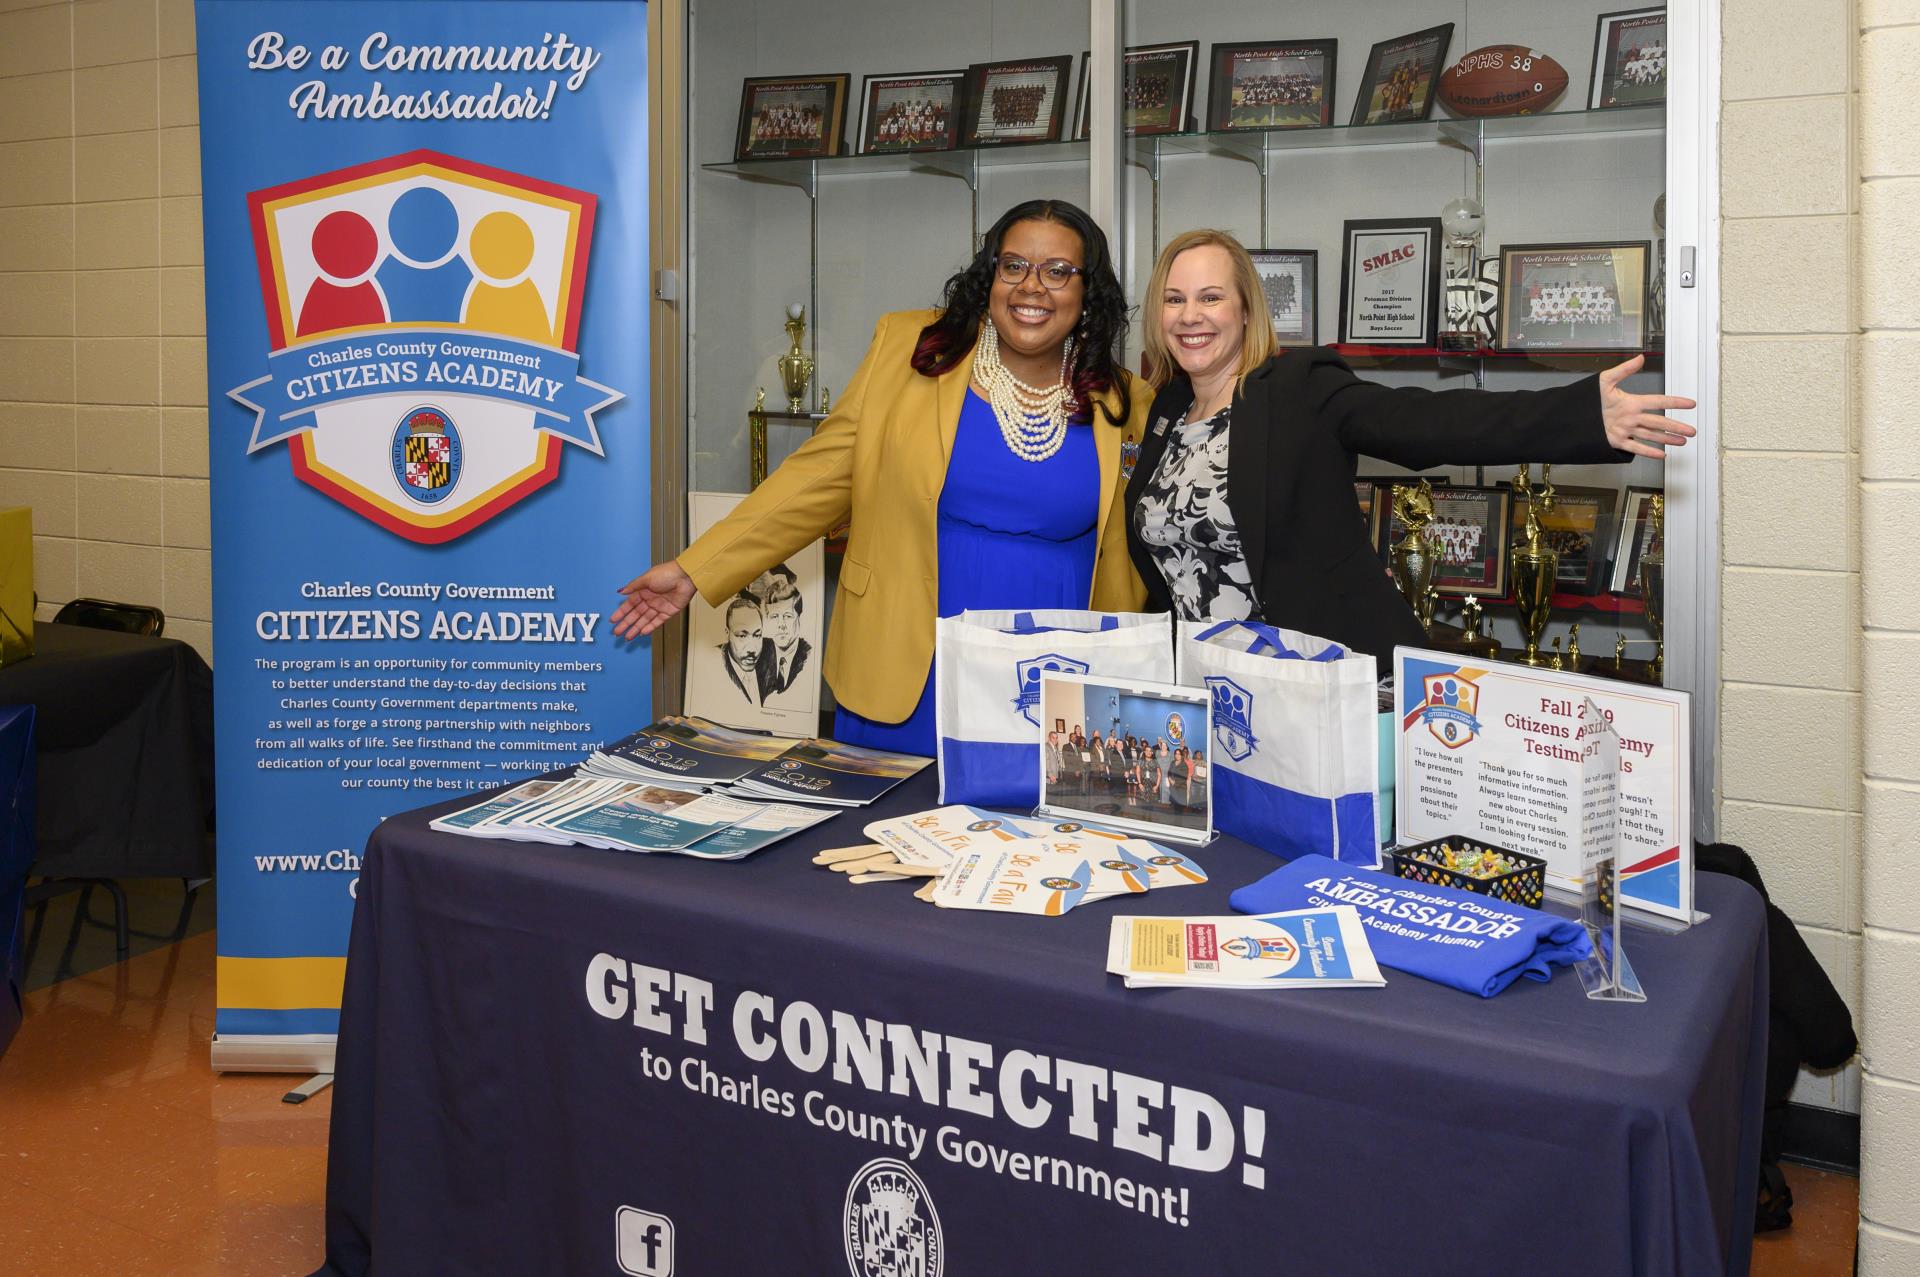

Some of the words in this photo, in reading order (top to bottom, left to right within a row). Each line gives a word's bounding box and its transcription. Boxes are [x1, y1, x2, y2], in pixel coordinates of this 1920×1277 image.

[247, 32, 312, 69] Be
[320, 45, 349, 70] a
[360, 31, 601, 91] Community
[1456, 52, 1504, 77] NPHS
[1510, 56, 1532, 72] 38
[289, 80, 557, 119] Ambassador!
[1362, 244, 1416, 272] SMAC
[1387, 314, 1398, 322] High
[308, 346, 372, 367] Charles
[377, 342, 437, 358] County
[441, 342, 541, 369] Government
[287, 361, 418, 400] CITIZENS
[425, 361, 563, 402] ACADEMY
[301, 581, 371, 597] Charles
[376, 582, 441, 601] County
[446, 583, 554, 599] Government
[256, 610, 420, 640] CITIZENS
[429, 610, 600, 642] ACADEMY
[254, 658, 277, 669] The
[282, 660, 335, 671] program
[340, 658, 350, 668] is
[354, 660, 369, 668] an
[374, 657, 447, 671] opportunity
[450, 658, 468, 669] for
[472, 659, 541, 673] community
[544, 660, 602, 671] members
[272, 680, 285, 689] to
[289, 678, 328, 688] better
[333, 677, 405, 688] understand
[410, 677, 429, 688] the
[433, 678, 497, 692] day-to-day
[501, 679, 557, 690] decisions
[561, 680, 586, 691] that
[281, 698, 327, 708] Charles
[332, 698, 377, 710] County
[381, 697, 455, 709] Government
[459, 699, 538, 712] departments
[542, 700, 577, 712] make,
[1541, 698, 1572, 717] Fall
[268, 721, 282, 729] as
[286, 718, 311, 728] well
[316, 720, 329, 728] as
[334, 717, 366, 730] forge
[382, 718, 422, 730] strong
[426, 719, 495, 732] partnership
[499, 719, 526, 730] with
[530, 720, 591, 733] neighbors
[1505, 713, 1569, 738] Citizens
[255, 738, 285, 748] from
[290, 738, 304, 748] all
[309, 737, 344, 748] walks
[348, 737, 361, 748] of
[365, 737, 388, 747] life.
[392, 737, 414, 747] See
[418, 737, 471, 749] firsthand
[476, 739, 496, 749] the
[500, 740, 577, 751] commitment
[581, 741, 604, 751] and
[257, 758, 323, 768] dedication
[328, 757, 341, 768] of
[344, 759, 372, 770] your
[377, 756, 405, 767] local
[409, 759, 481, 770] government
[501, 759, 550, 773] working
[553, 761, 566, 770] to
[633, 746, 699, 768] 2019
[1423, 749, 1437, 759] love
[1438, 751, 1452, 762] how
[1454, 756, 1463, 764] all
[774, 767, 832, 787] 2019
[1414, 759, 1426, 767] the
[1427, 761, 1463, 776] presenters
[1479, 761, 1505, 773] "Thank
[1507, 768, 1521, 777] you
[1523, 771, 1534, 780] for
[1547, 776, 1568, 787] much
[342, 779, 363, 787] our
[367, 778, 410, 790] county
[413, 777, 432, 788] the
[437, 778, 462, 789] best
[466, 779, 474, 789] it
[478, 781, 499, 789] can
[1426, 775, 1441, 783] were
[1478, 773, 1520, 789] informative
[1522, 784, 1568, 800] information.
[1420, 785, 1457, 799] passionate
[1479, 786, 1505, 798] Always
[1507, 792, 1526, 803] learn
[1528, 796, 1568, 814] something
[1626, 794, 1653, 806] wasn't
[1420, 796, 1440, 807] about
[1441, 801, 1458, 811] their
[1489, 800, 1503, 810] new
[1505, 802, 1526, 815] about
[1529, 810, 1557, 823] Charles
[1426, 810, 1452, 821] topics."
[1478, 810, 1505, 824] County
[1507, 816, 1514, 824] in
[1516, 819, 1536, 831] every
[1538, 824, 1568, 837] session.
[1645, 811, 1658, 820] I'm
[1485, 825, 1496, 833] am
[1498, 825, 1525, 841] looking
[1527, 833, 1557, 848] forward
[1559, 841, 1567, 850] to
[1625, 820, 1643, 830] that
[1645, 823, 1663, 836] they
[1501, 840, 1518, 851] next
[1520, 845, 1544, 856] week."
[1624, 832, 1632, 840] to
[1635, 835, 1664, 847] share."
[1011, 854, 1040, 867] Be
[1003, 869, 1024, 877] a
[990, 881, 1027, 905] Fan
[1350, 881, 1378, 890] am
[1393, 890, 1457, 908] Charles
[1458, 901, 1524, 923] County
[1304, 877, 1521, 940] AMBASSADOR
[1363, 916, 1427, 941] Academy
[1429, 933, 1484, 949] Alumni
[586, 953, 713, 1046] GET
[732, 990, 1266, 1190] CONNECTED!
[640, 1047, 672, 1081] to
[681, 1058, 795, 1117] Charles
[804, 1091, 926, 1160] County
[937, 1126, 1189, 1227] Government!
[850, 1203, 863, 1259] CHARLES
